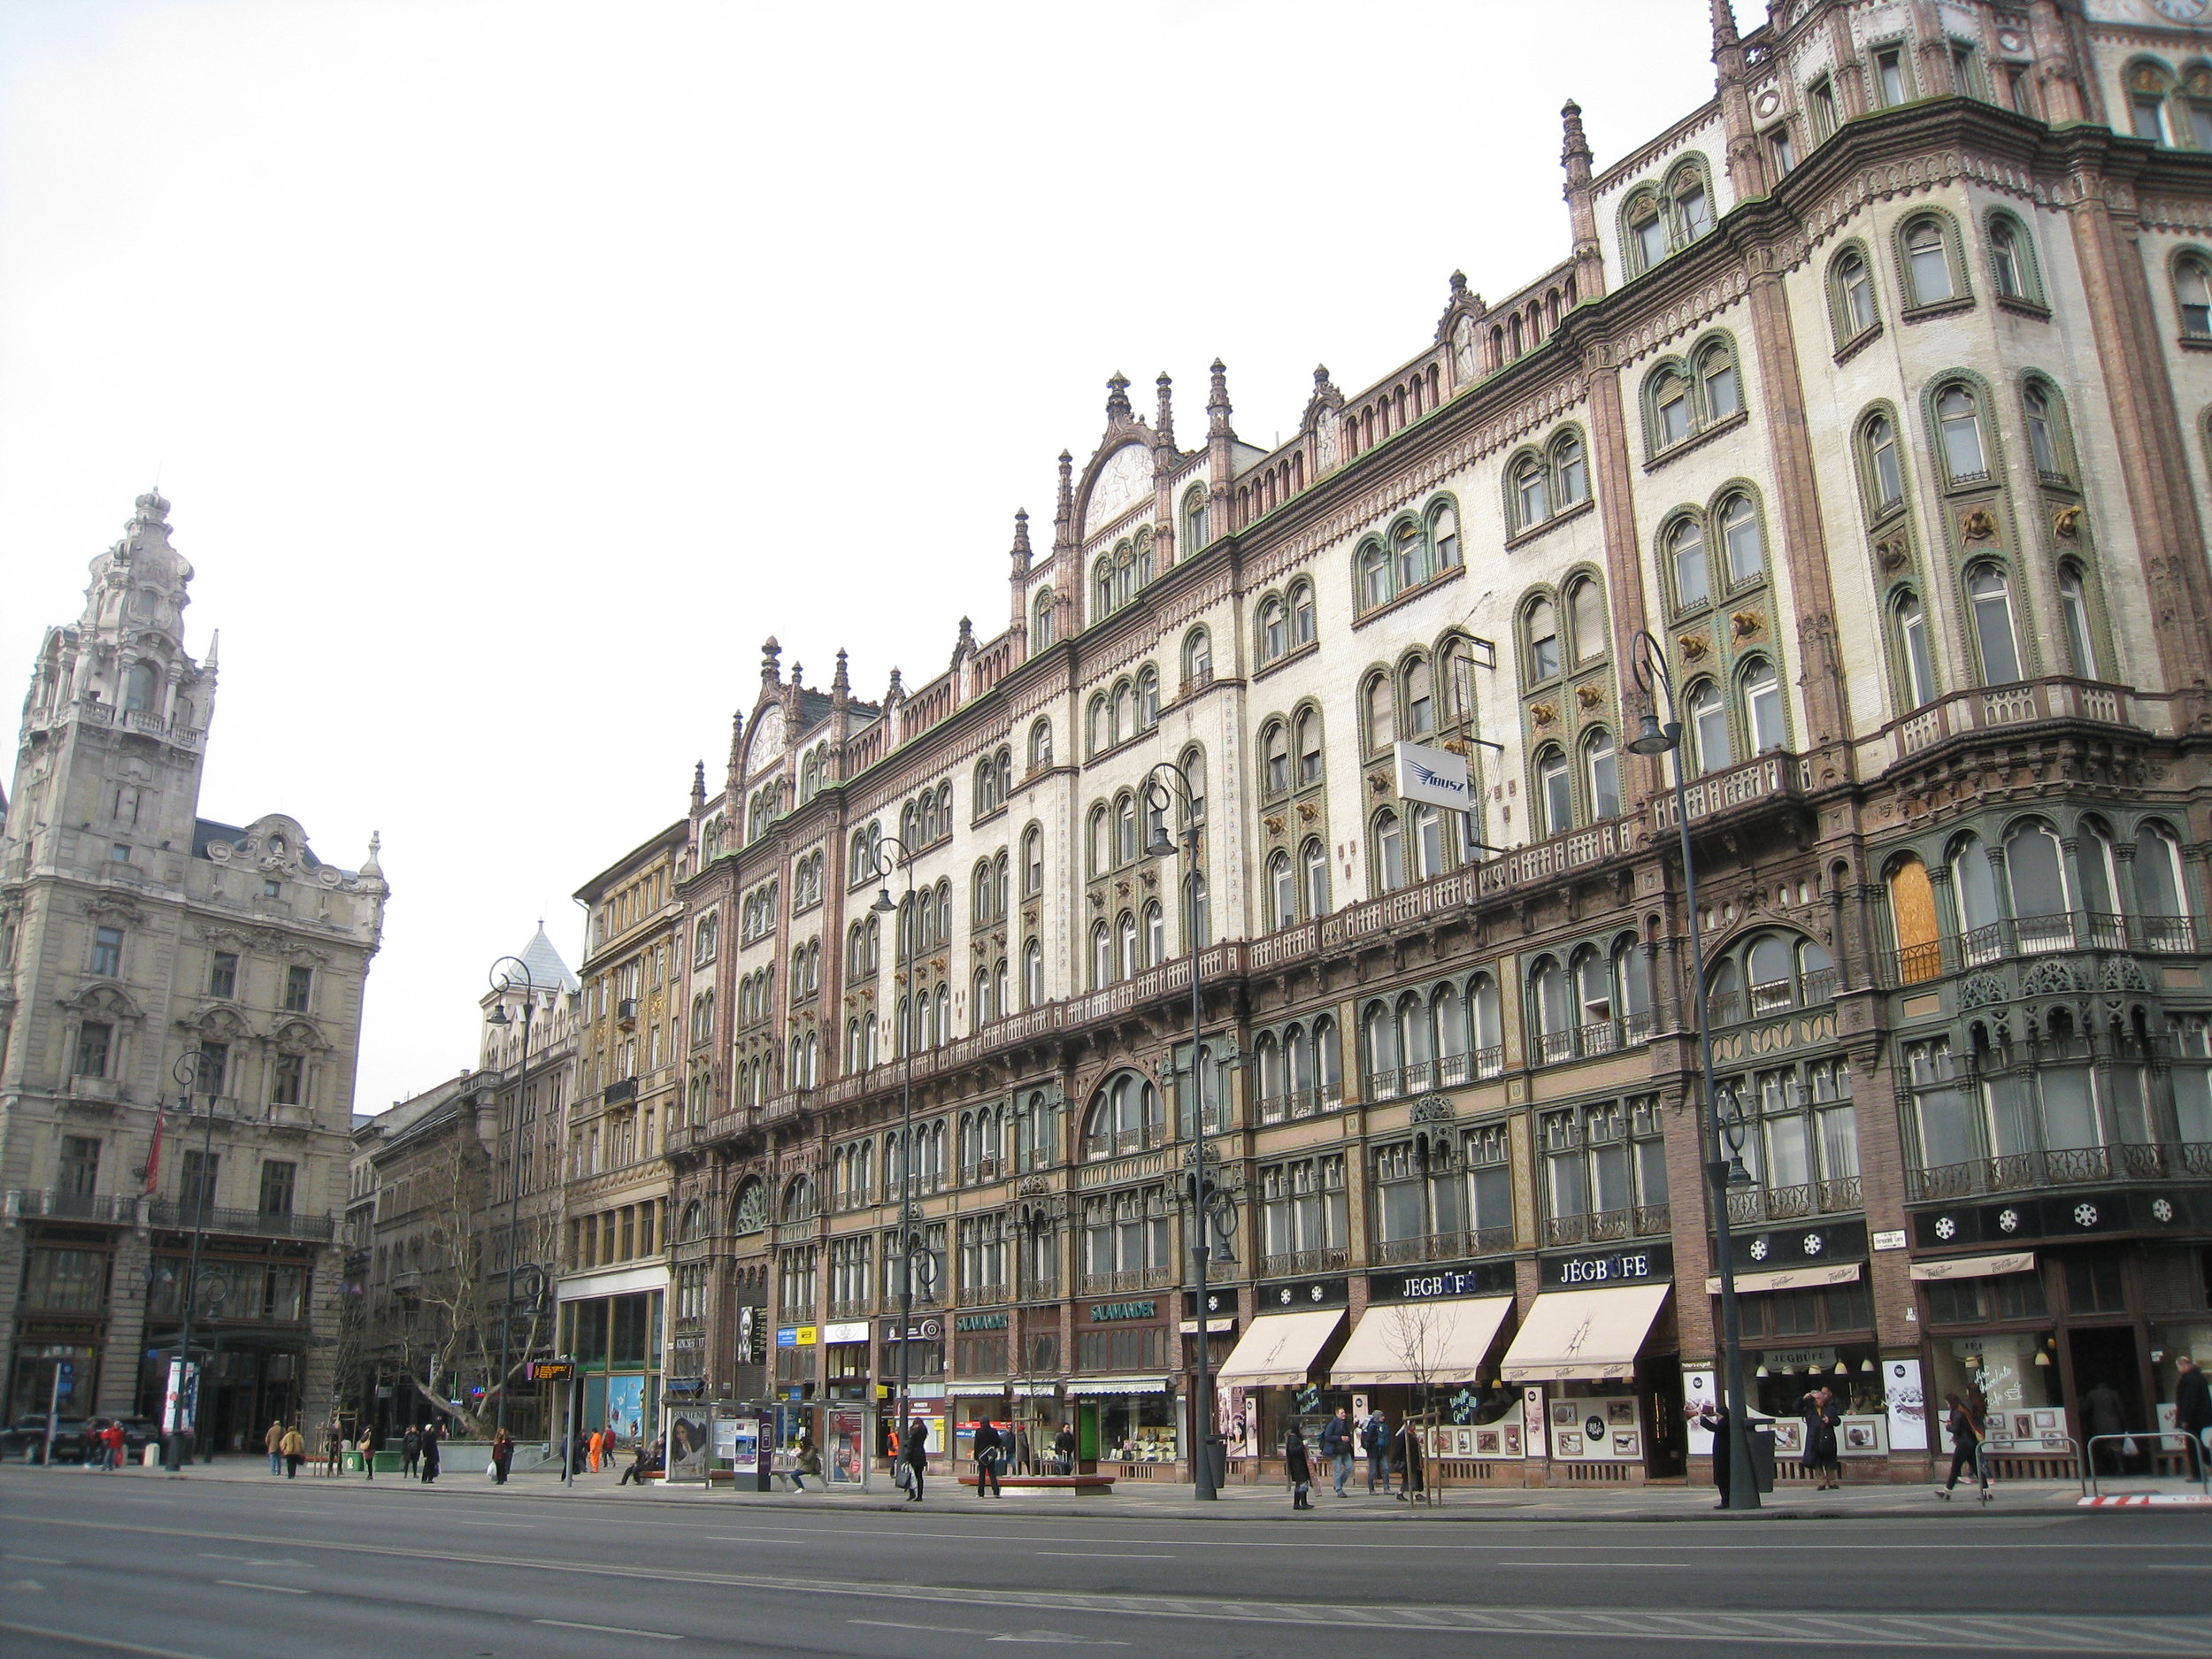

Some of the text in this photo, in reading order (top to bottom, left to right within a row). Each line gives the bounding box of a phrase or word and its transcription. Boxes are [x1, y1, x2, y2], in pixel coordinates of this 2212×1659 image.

[1428, 775, 1465, 792] IBUSZ
[1090, 1301, 1155, 1321] SALAMANDER
[956, 1314, 1009, 1332] SALAMANDER
[672, 1409, 707, 1419] PANTENE
